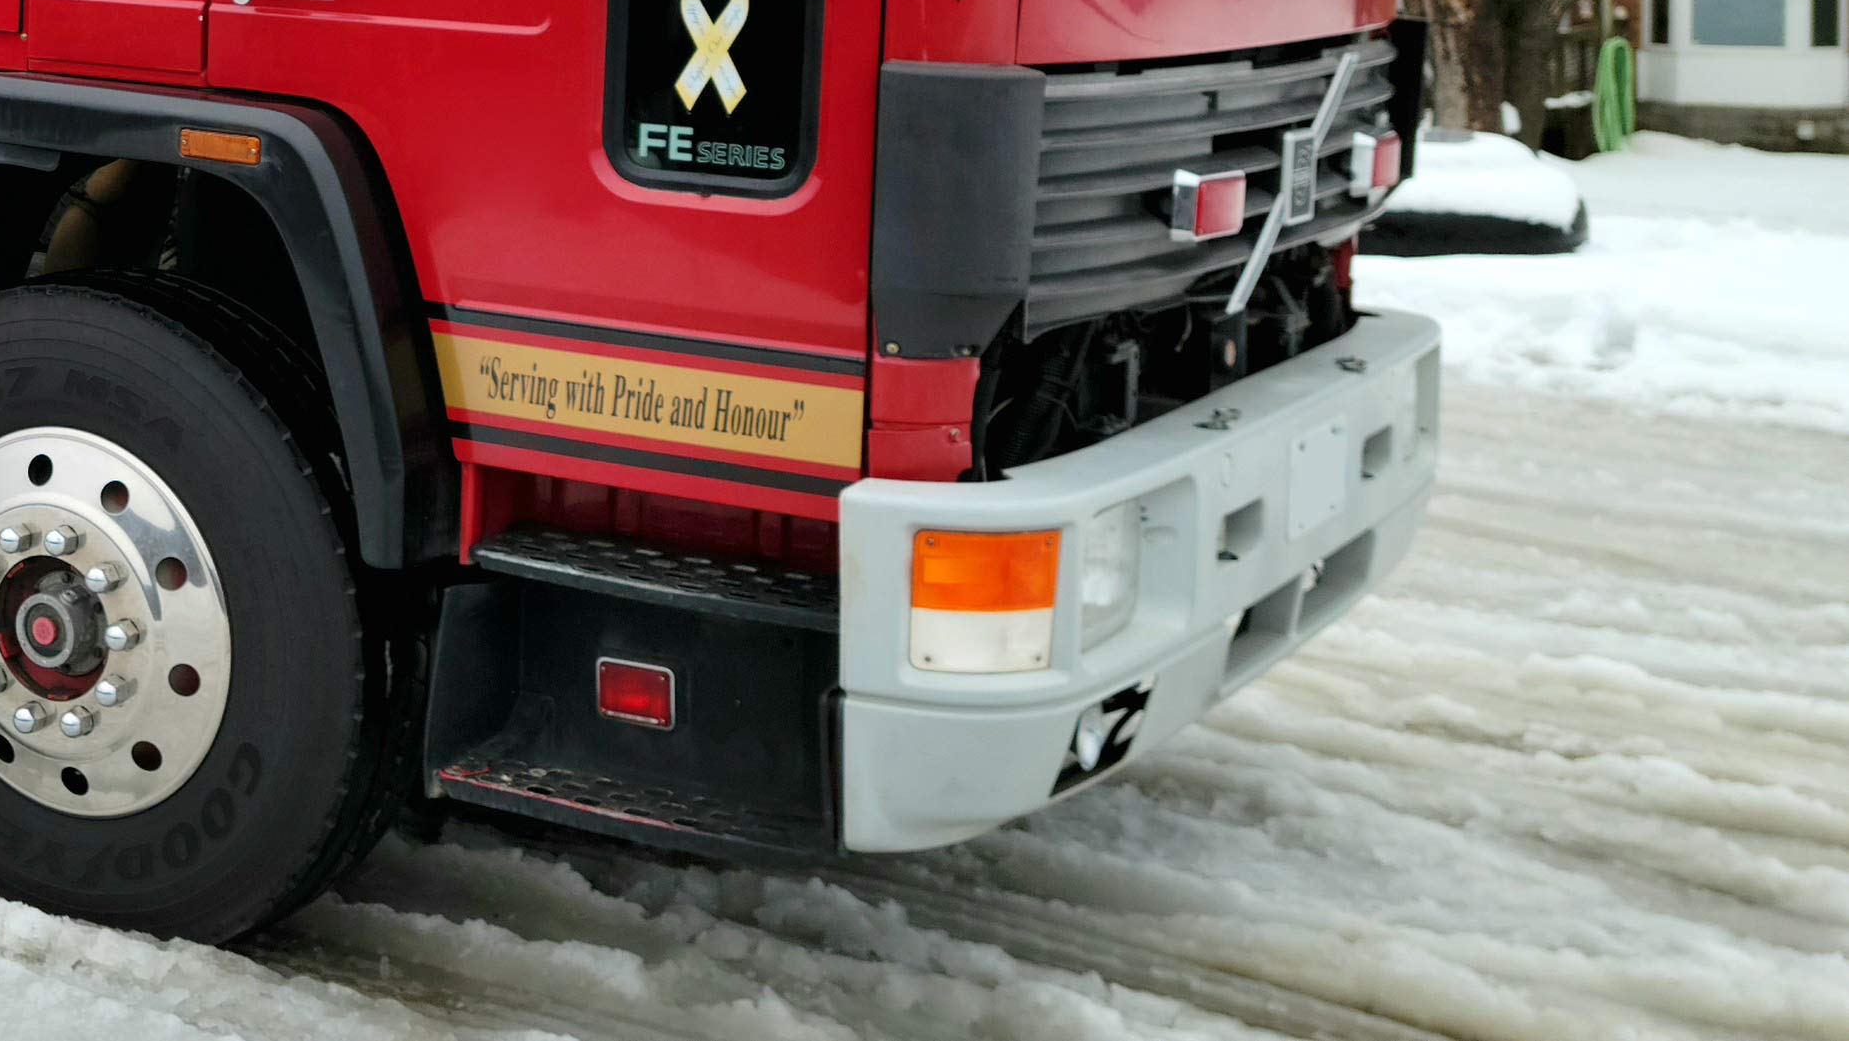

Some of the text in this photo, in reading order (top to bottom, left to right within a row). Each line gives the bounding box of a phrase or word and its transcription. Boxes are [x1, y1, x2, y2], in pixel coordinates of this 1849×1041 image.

[638, 122, 786, 171] FE SERIES
[479, 354, 806, 443] “Serving with Pride and Honour”
